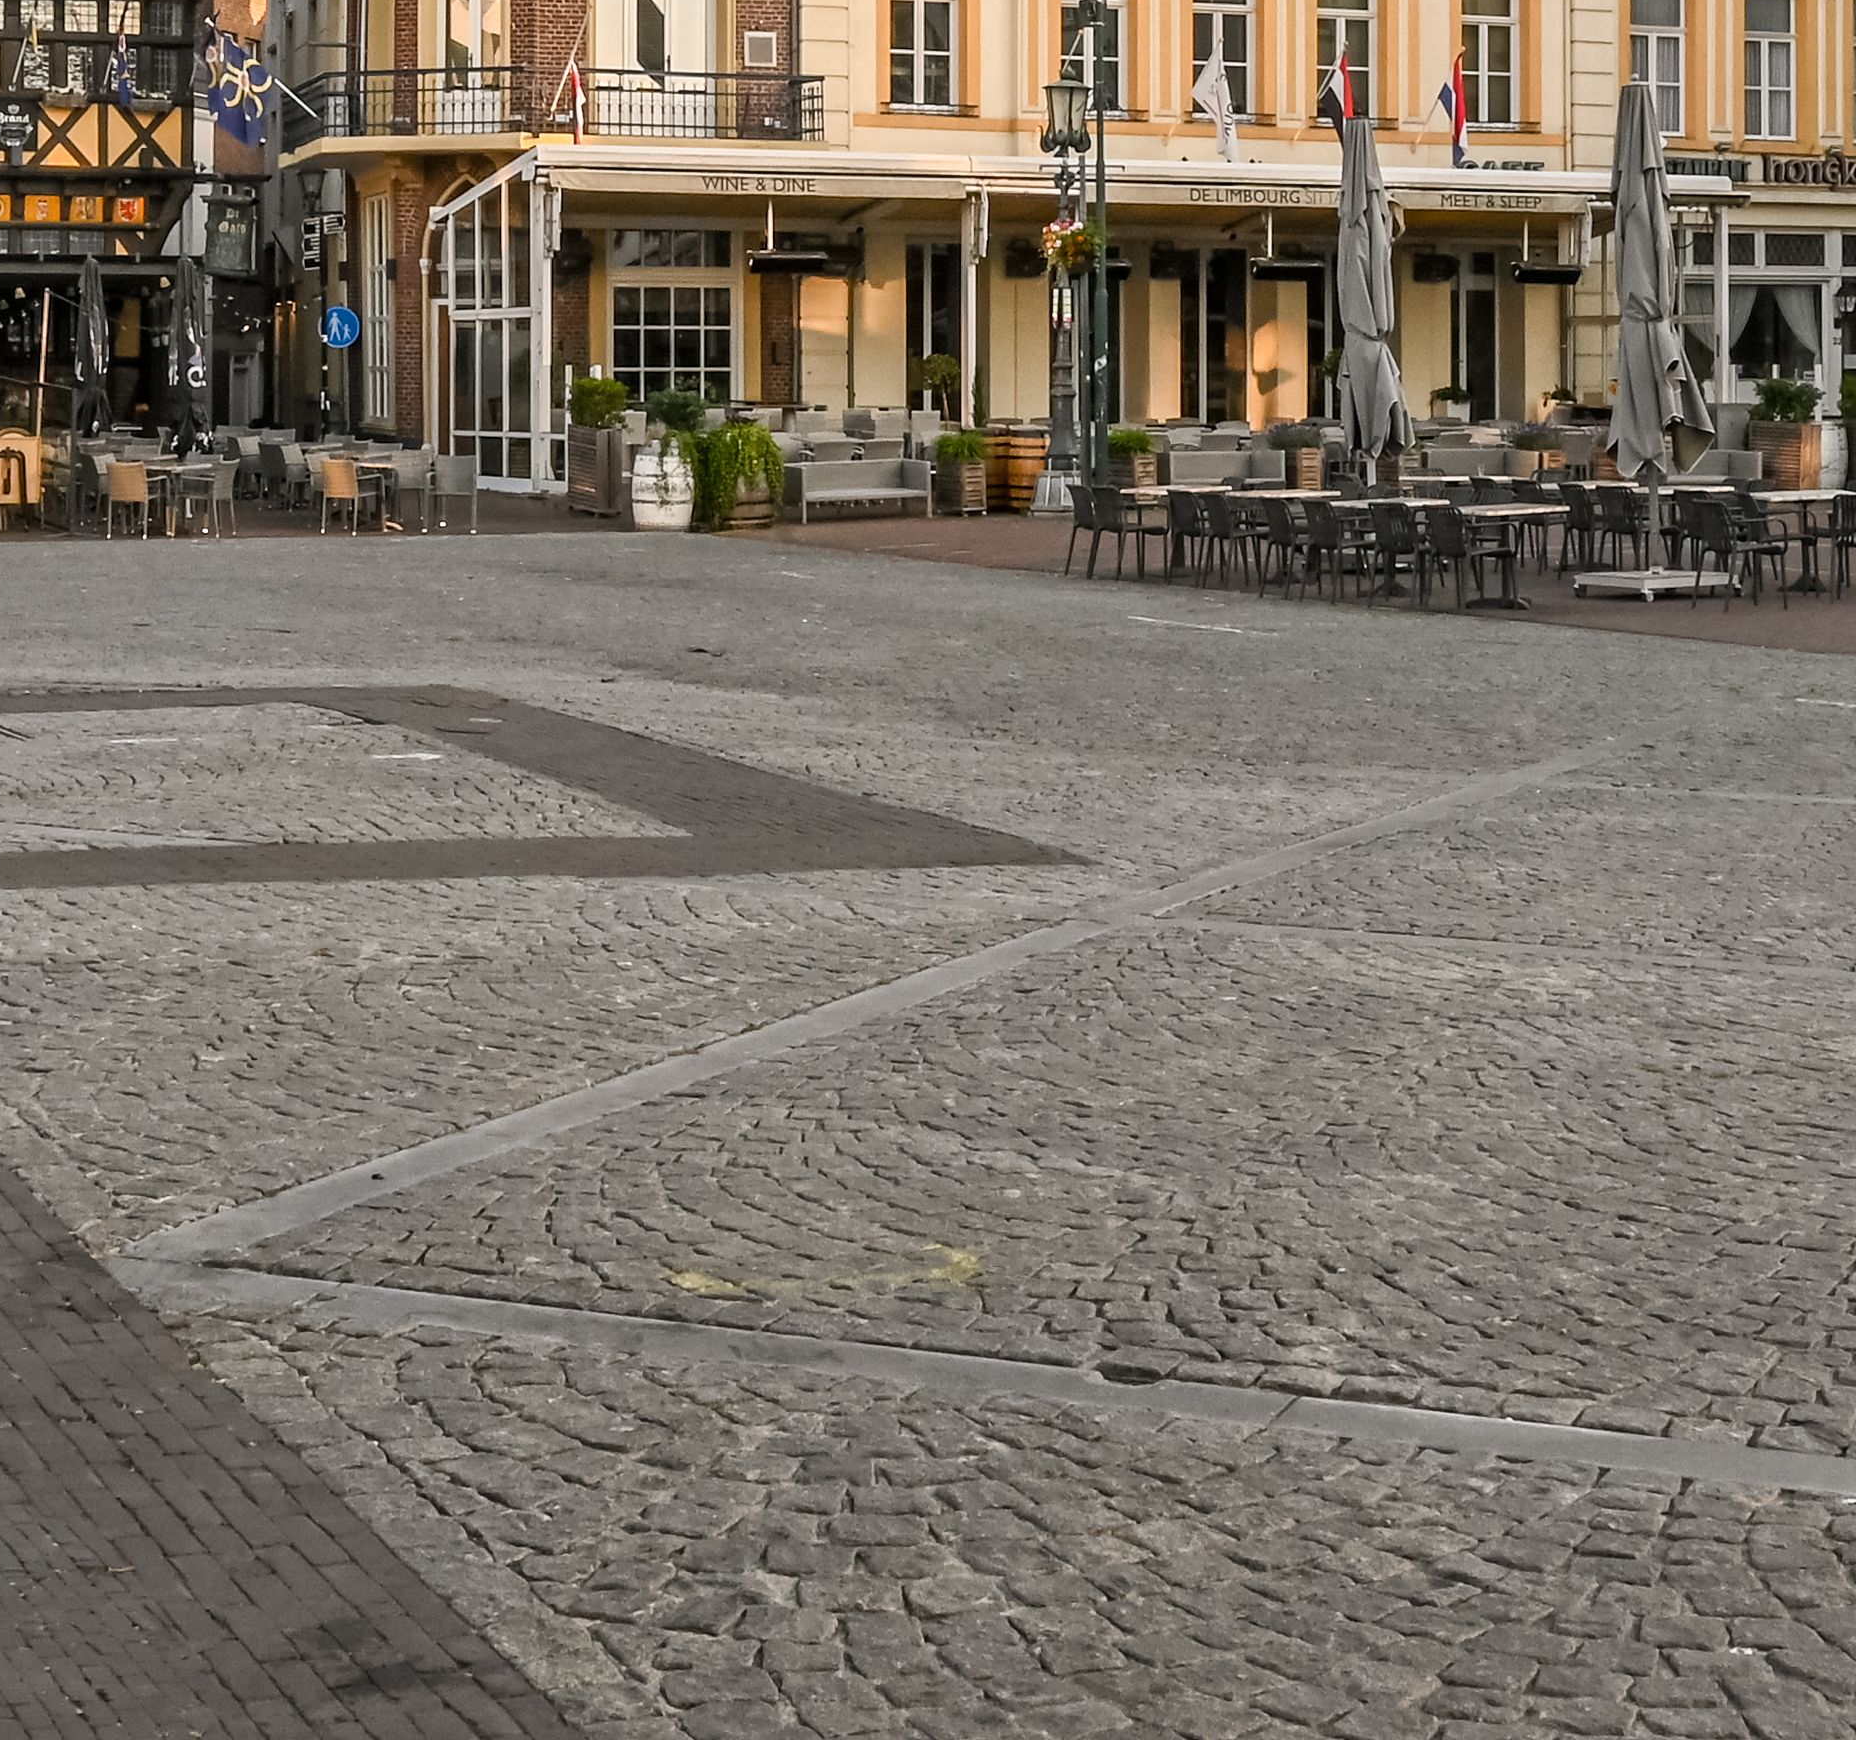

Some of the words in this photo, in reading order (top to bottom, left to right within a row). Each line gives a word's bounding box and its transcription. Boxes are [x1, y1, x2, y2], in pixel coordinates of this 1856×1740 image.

[701, 176, 749, 191] WINE
[755, 177, 766, 191] &
[773, 178, 816, 192] DINE
[1189, 188, 1211, 202] DE
[1215, 189, 1301, 204] LIMBOURG
[1440, 194, 1479, 208] MEET
[1485, 195, 1495, 208] &
[1499, 195, 1543, 209] SLEEP
